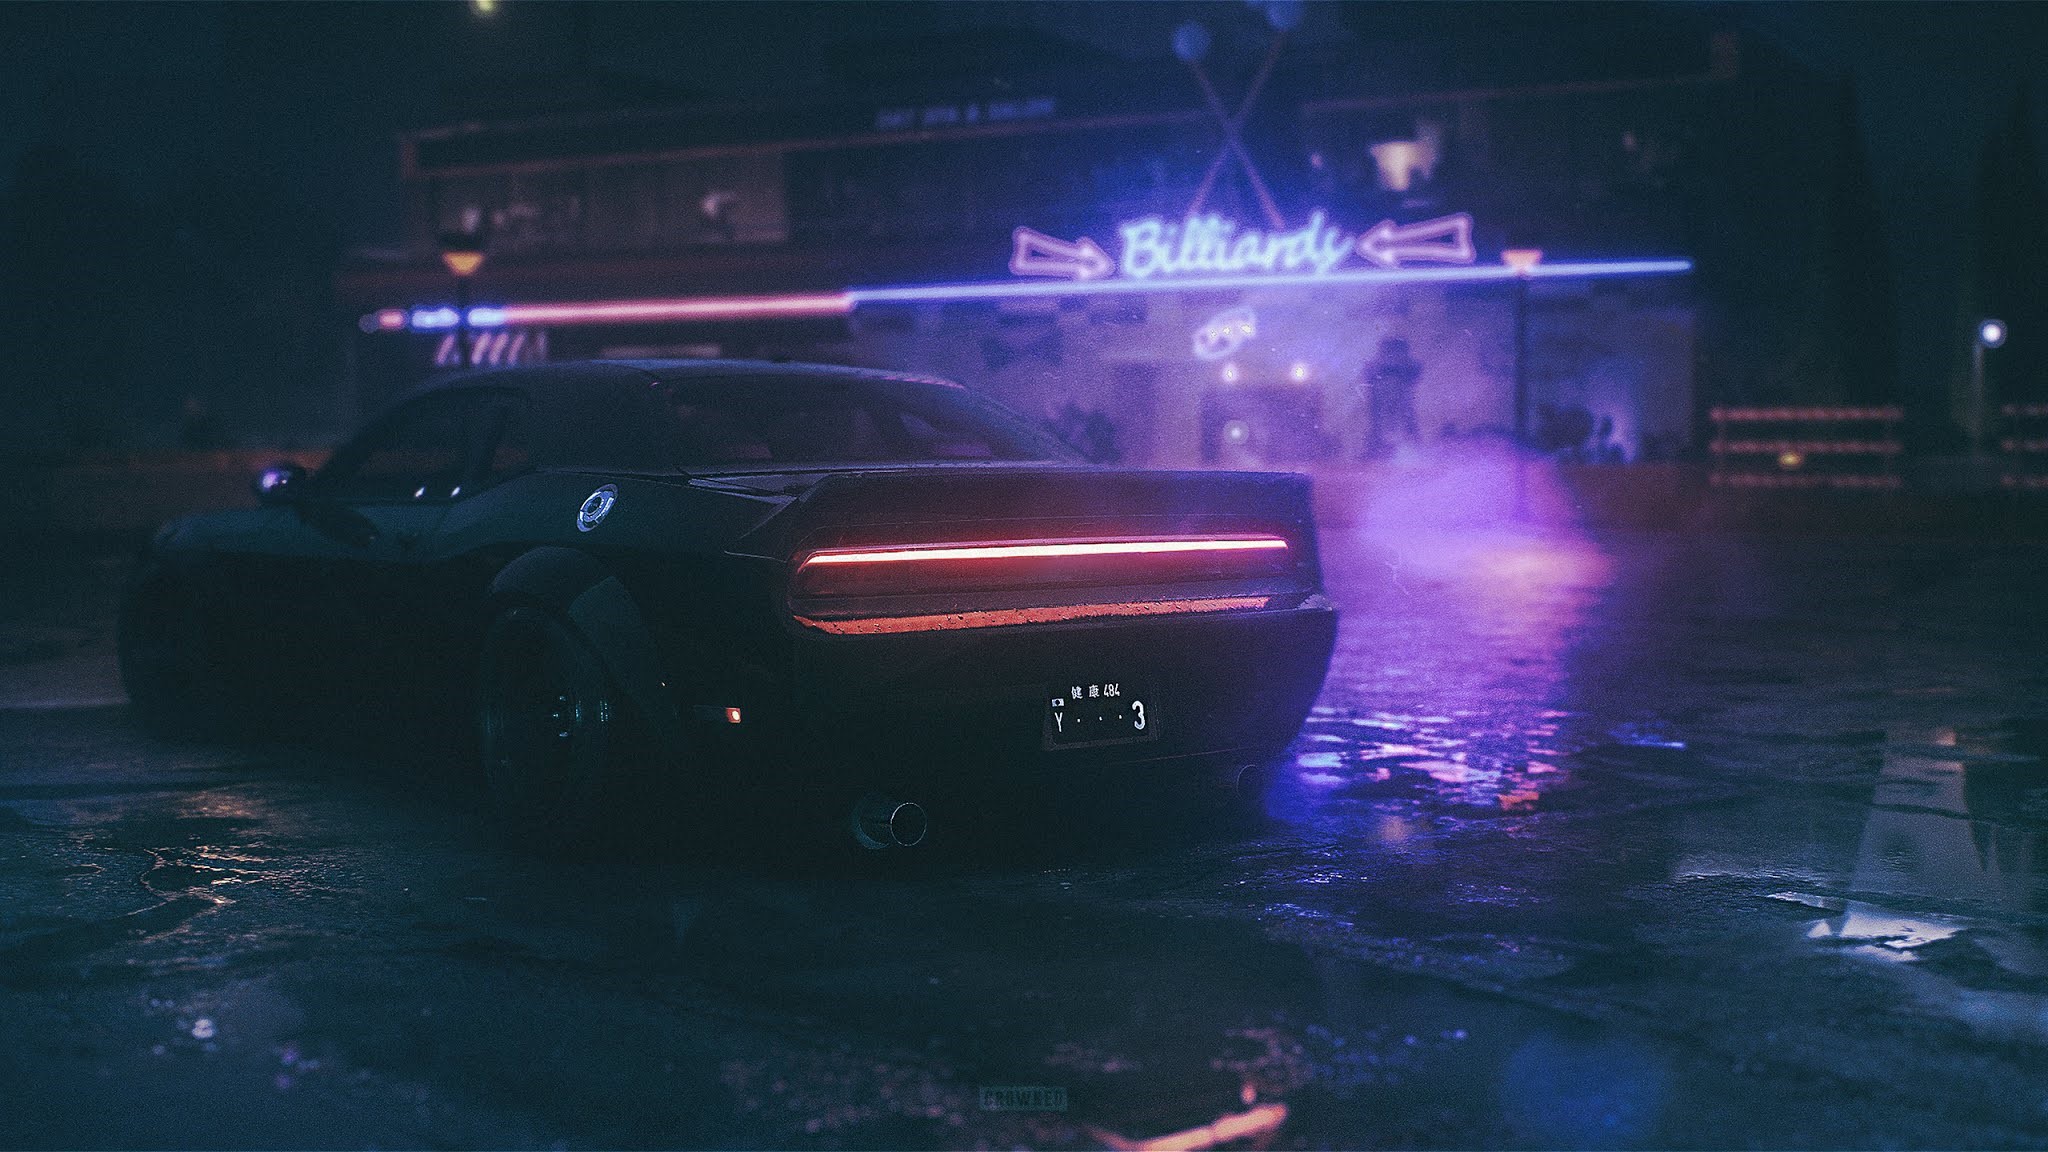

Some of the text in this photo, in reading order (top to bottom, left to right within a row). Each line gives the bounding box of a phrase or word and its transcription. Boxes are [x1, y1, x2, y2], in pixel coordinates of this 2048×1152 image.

[1120, 208, 1355, 277] Billiards
[1103, 683, 1121, 698] 484
[1054, 700, 1146, 733] Y 3
